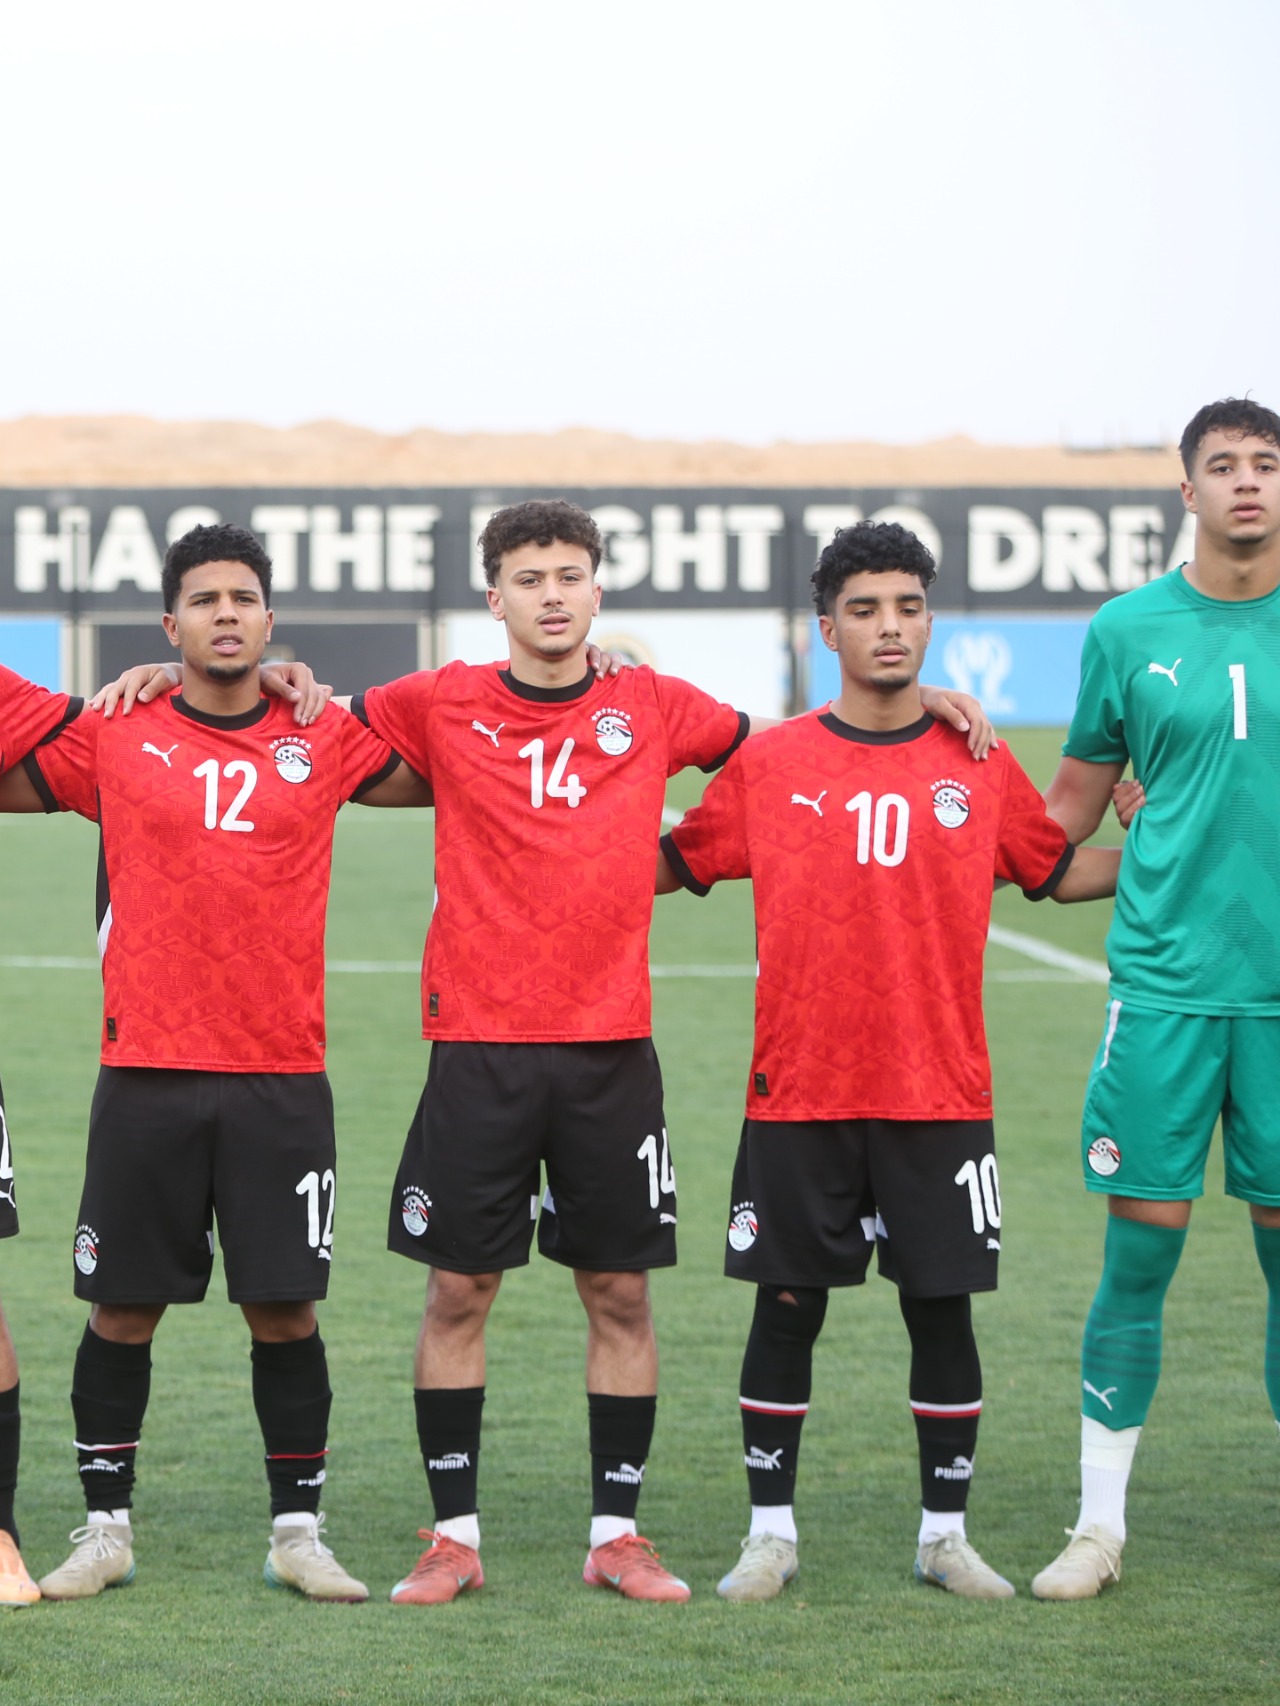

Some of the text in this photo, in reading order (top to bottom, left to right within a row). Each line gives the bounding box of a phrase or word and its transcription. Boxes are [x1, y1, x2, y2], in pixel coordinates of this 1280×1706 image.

[251, 505, 440, 592] THE
[1229, 664, 1247, 740] 1
[193, 759, 258, 832] 12
[518, 737, 587, 808] 14
[845, 791, 910, 867] 10
[295, 1168, 335, 1248] 12
[954, 1153, 1001, 1234] 10
[428, 1459, 464, 1470] PUMA
[604, 1470, 639, 1485] PUMA
